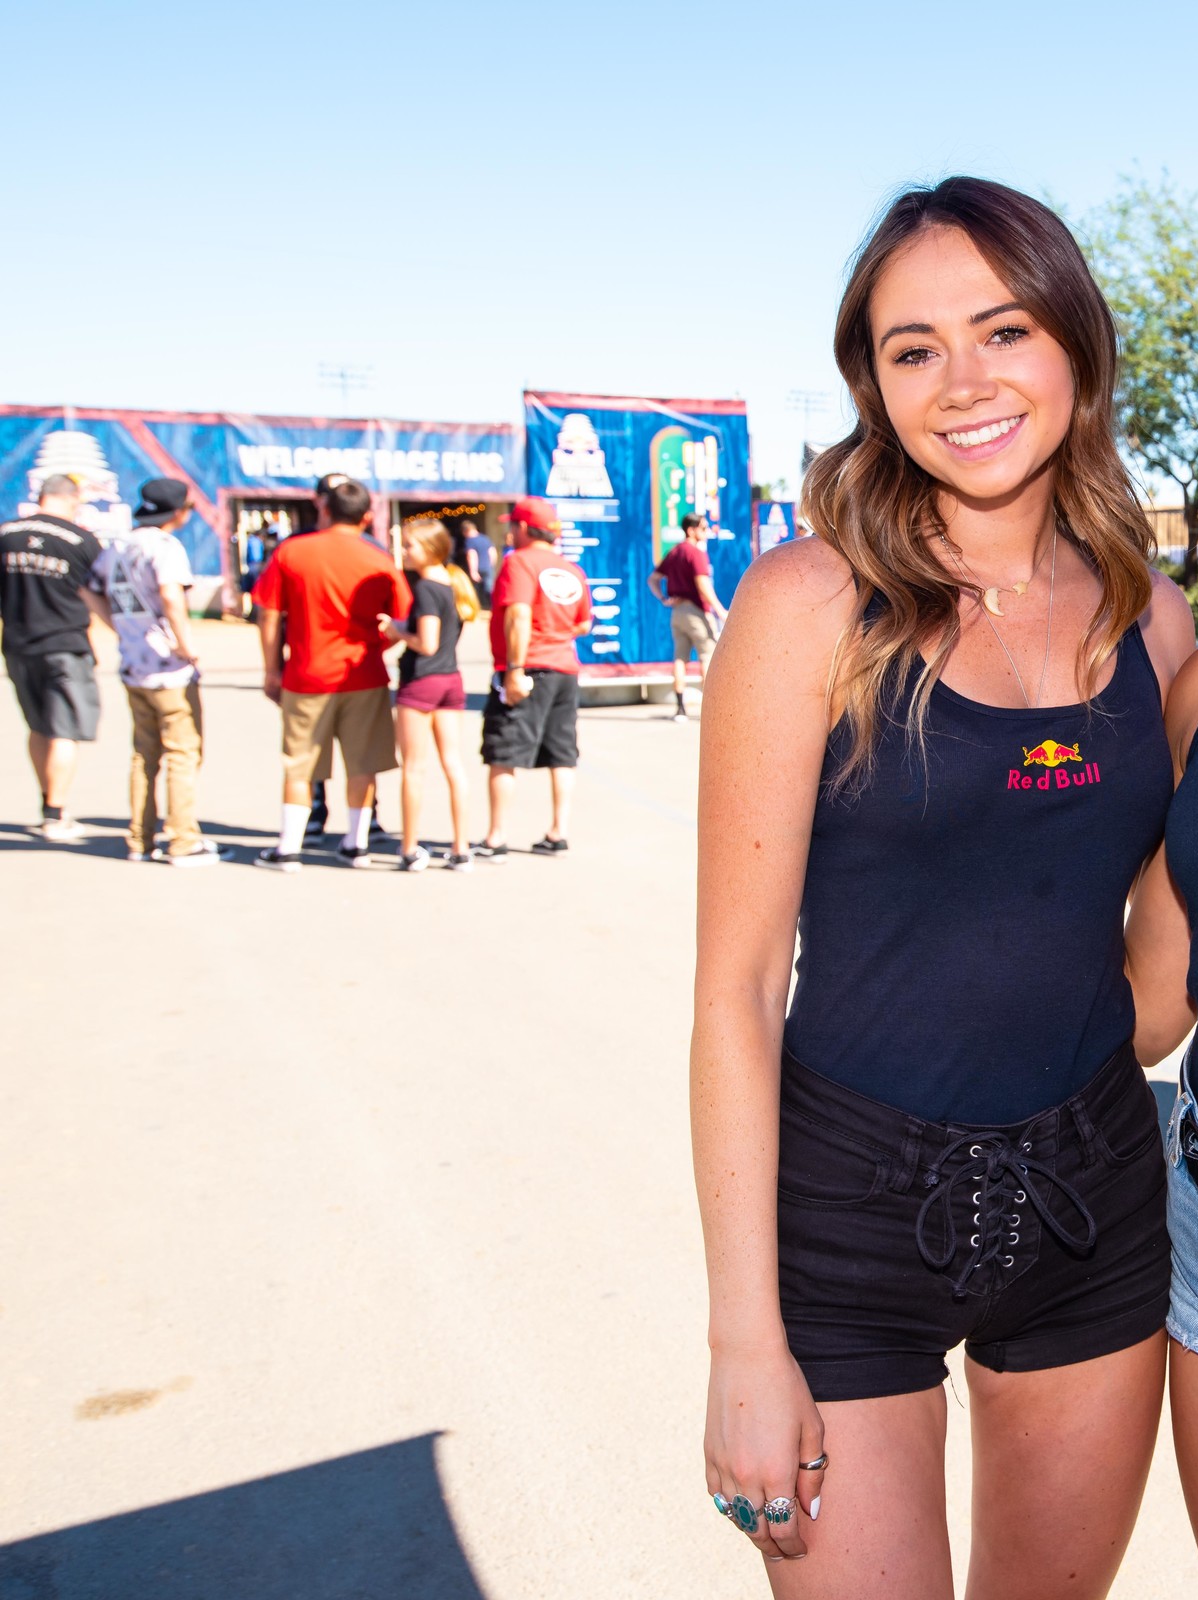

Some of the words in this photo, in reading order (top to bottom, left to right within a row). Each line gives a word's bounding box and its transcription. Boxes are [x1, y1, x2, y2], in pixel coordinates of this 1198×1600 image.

[238, 445, 371, 480] WELCOME
[374, 450, 440, 481] RACE
[441, 451, 504, 483] FANS
[1007, 769, 1050, 790] Red
[1055, 762, 1101, 789] Bull
